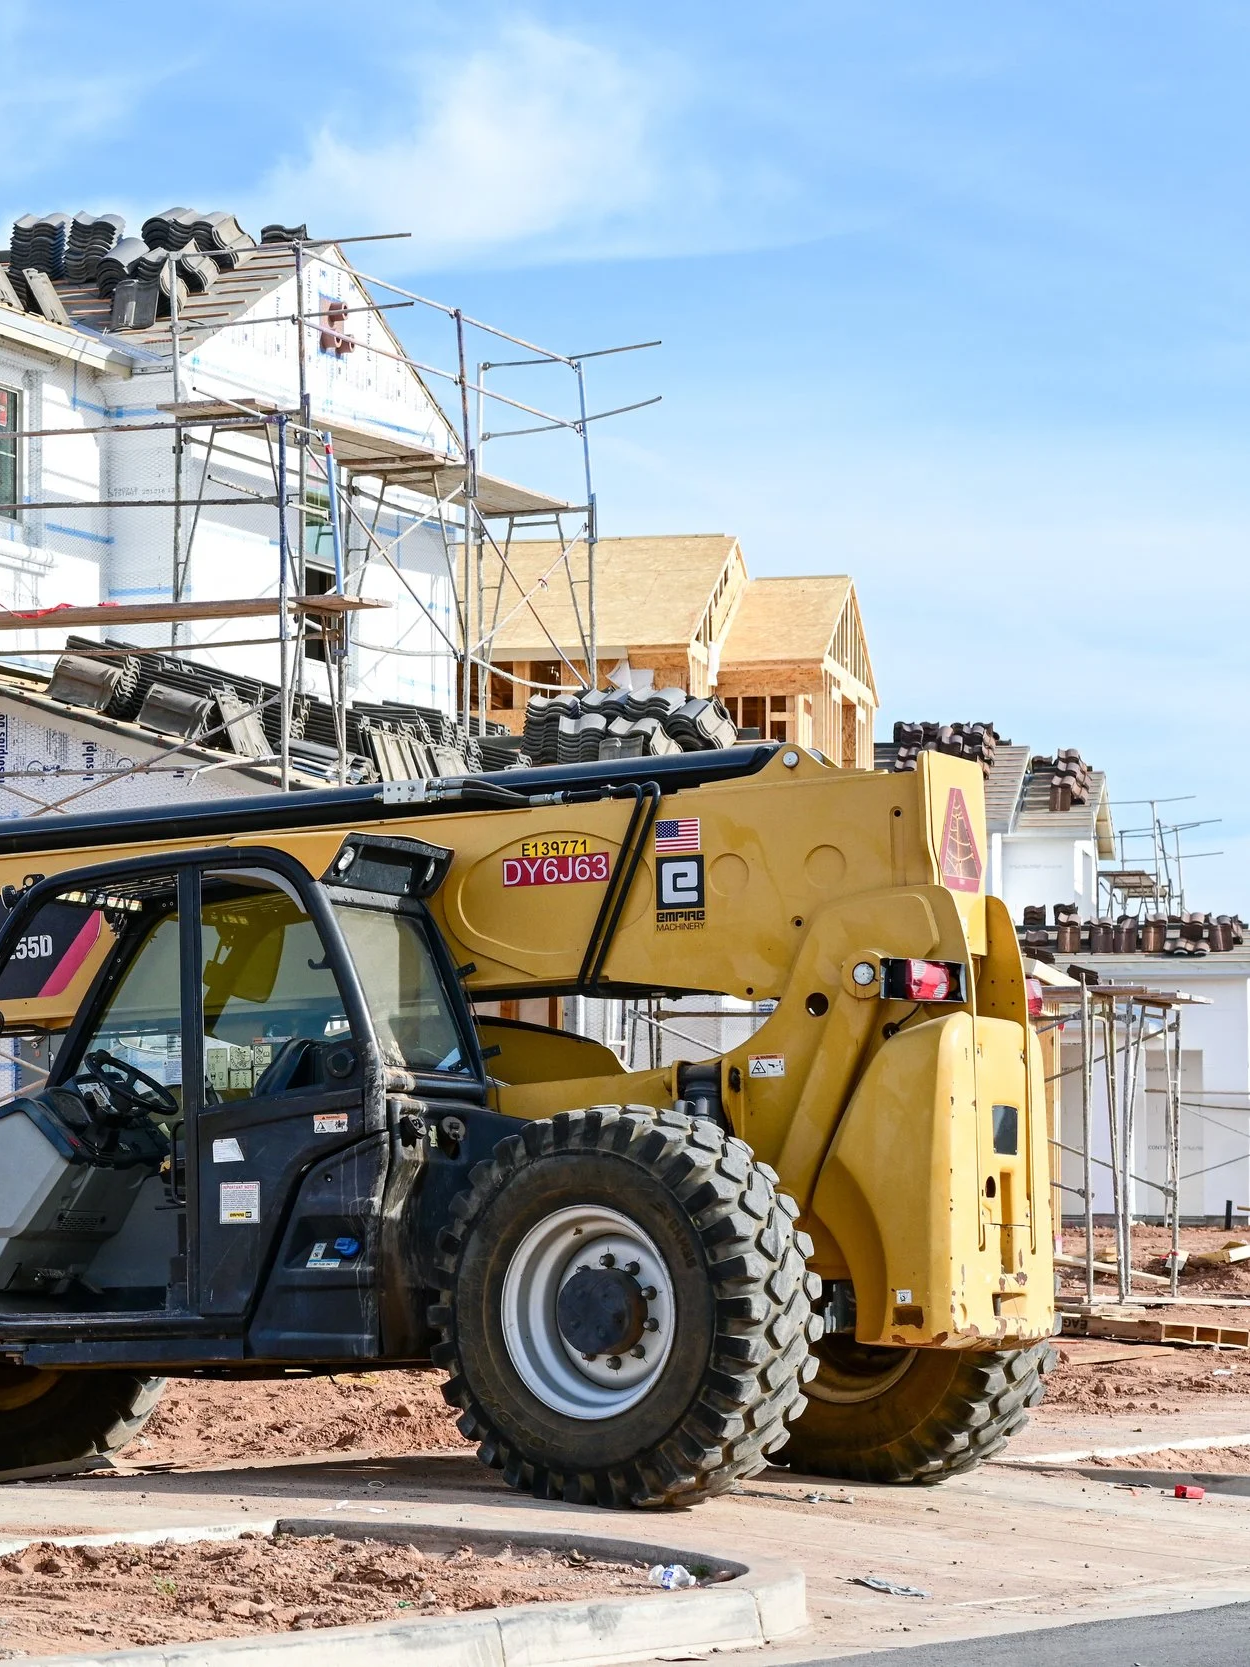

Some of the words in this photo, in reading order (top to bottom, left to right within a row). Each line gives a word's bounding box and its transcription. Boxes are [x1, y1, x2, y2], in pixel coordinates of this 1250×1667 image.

[521, 839, 587, 857] E139771
[503, 854, 607, 886] DY6J63
[656, 922, 705, 931] MACHINERY
